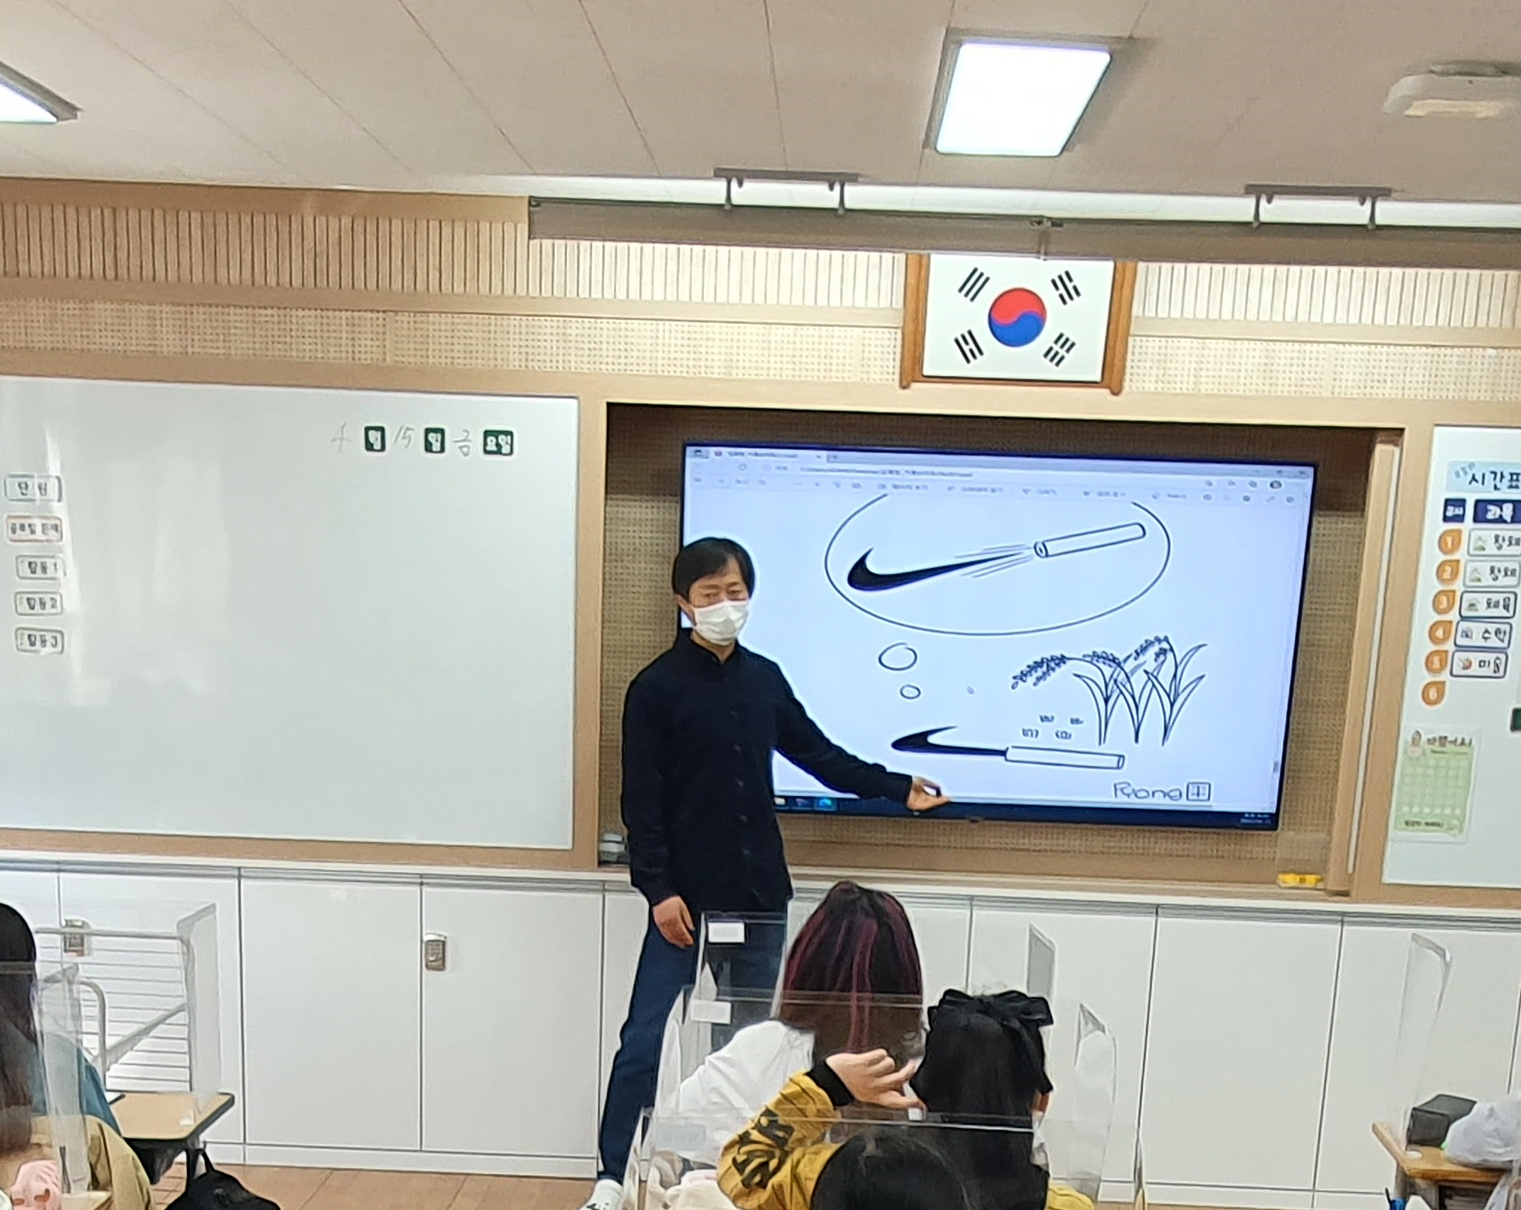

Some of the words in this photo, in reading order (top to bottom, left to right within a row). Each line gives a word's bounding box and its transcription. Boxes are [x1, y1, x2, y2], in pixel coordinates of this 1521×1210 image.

[394, 424, 416, 449] 15
[452, 429, 473, 457] 금
[1468, 470, 1521, 491] 시간표
[1481, 627, 1507, 643] 수학
